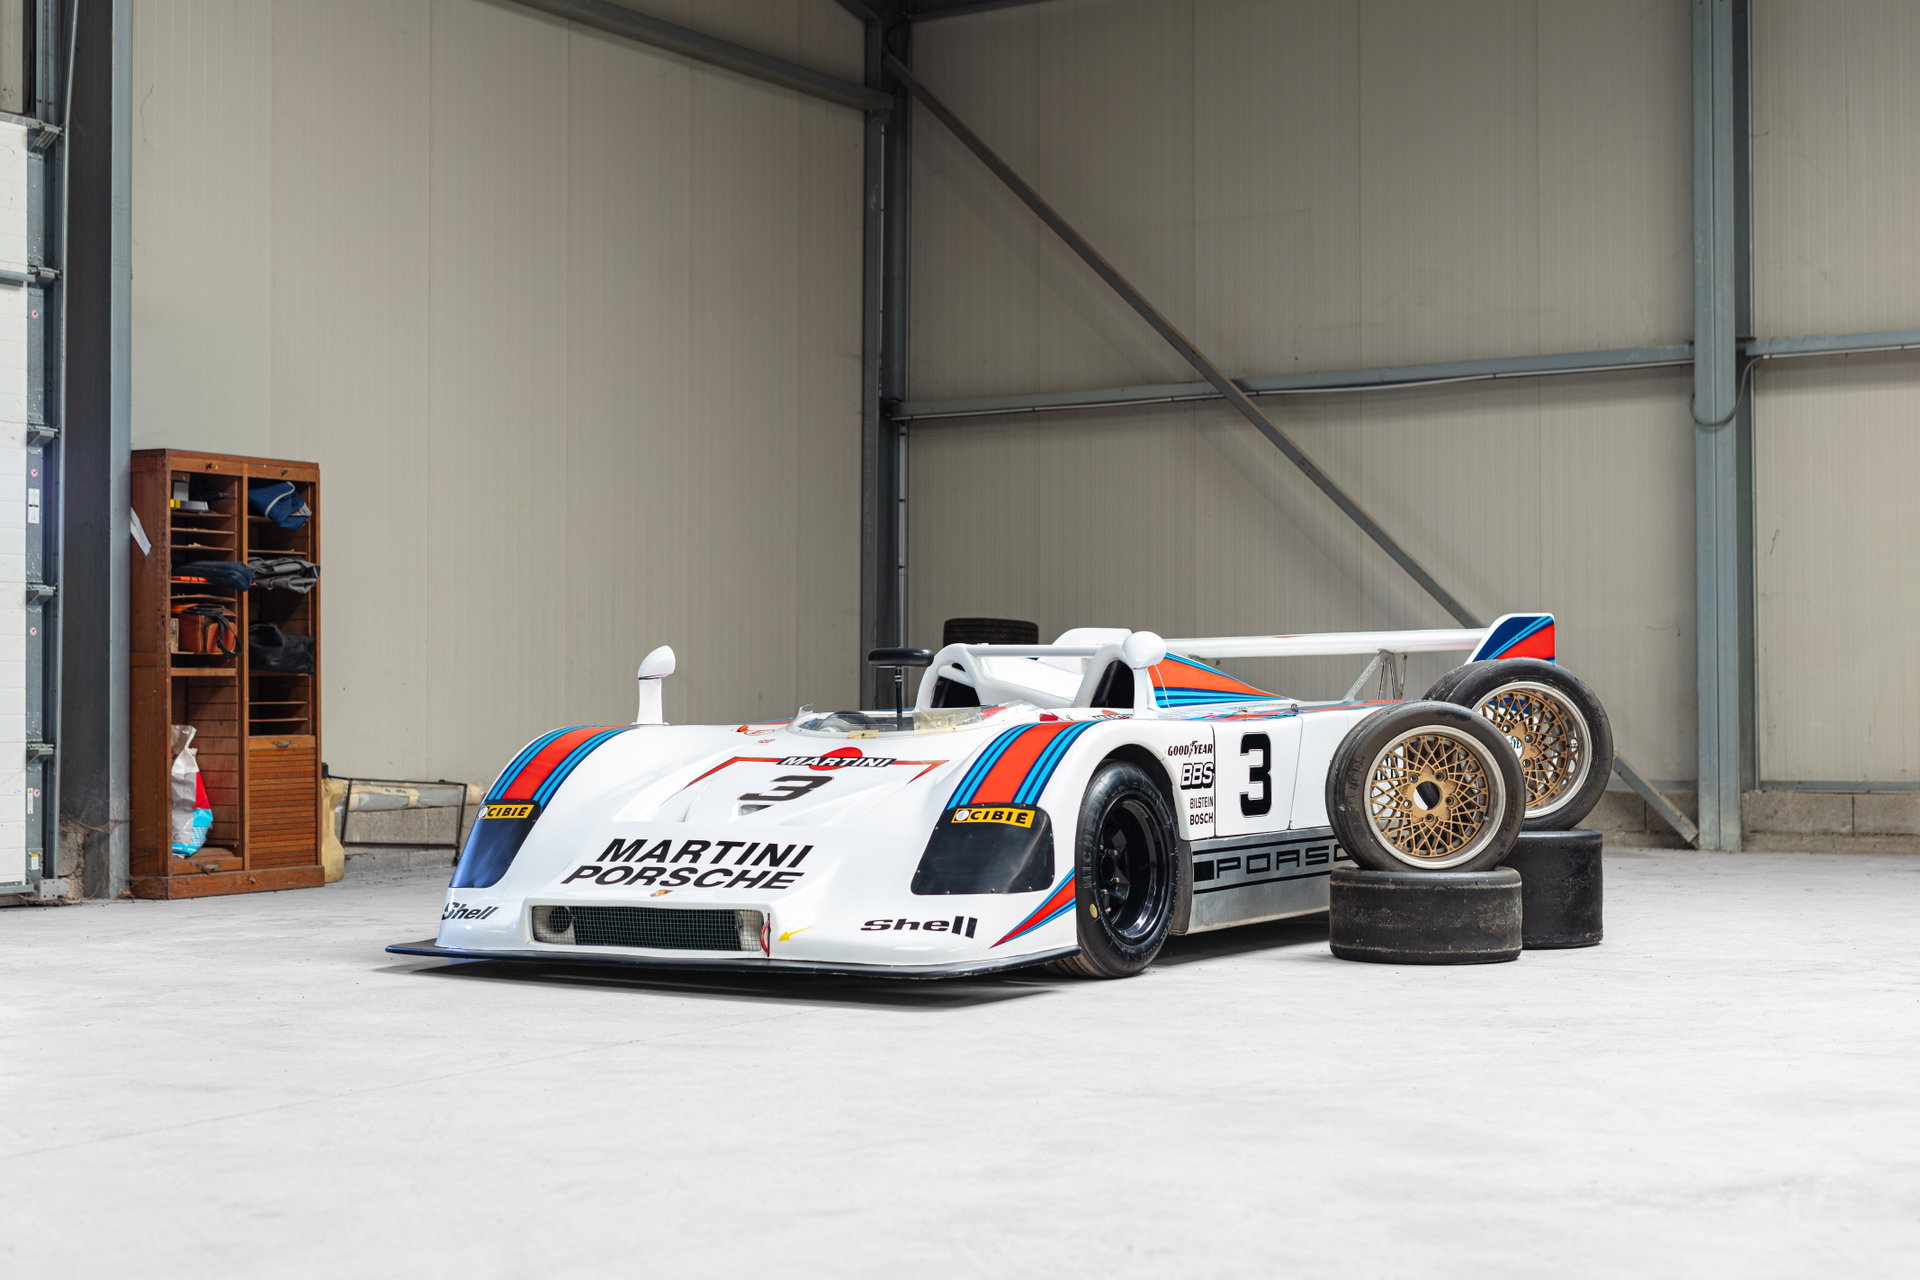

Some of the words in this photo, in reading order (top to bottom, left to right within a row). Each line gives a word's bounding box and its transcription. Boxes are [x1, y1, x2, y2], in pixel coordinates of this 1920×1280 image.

[1167, 741, 1213, 758] GOODYEAR
[781, 756, 892, 767] MARTINI
[1180, 762, 1215, 790] BBS
[1240, 732, 1272, 817] 3
[738, 775, 833, 801] 3
[487, 806, 528, 817] CIBIE
[1190, 797, 1213, 809] BILSTEIN
[970, 810, 1028, 824] CIBIE
[1189, 812, 1213, 825] BOSCH
[596, 838, 814, 868] MARTINI
[560, 865, 805, 889] PORSCHE
[441, 902, 499, 920] Shell
[860, 915, 978, 939] Shell
